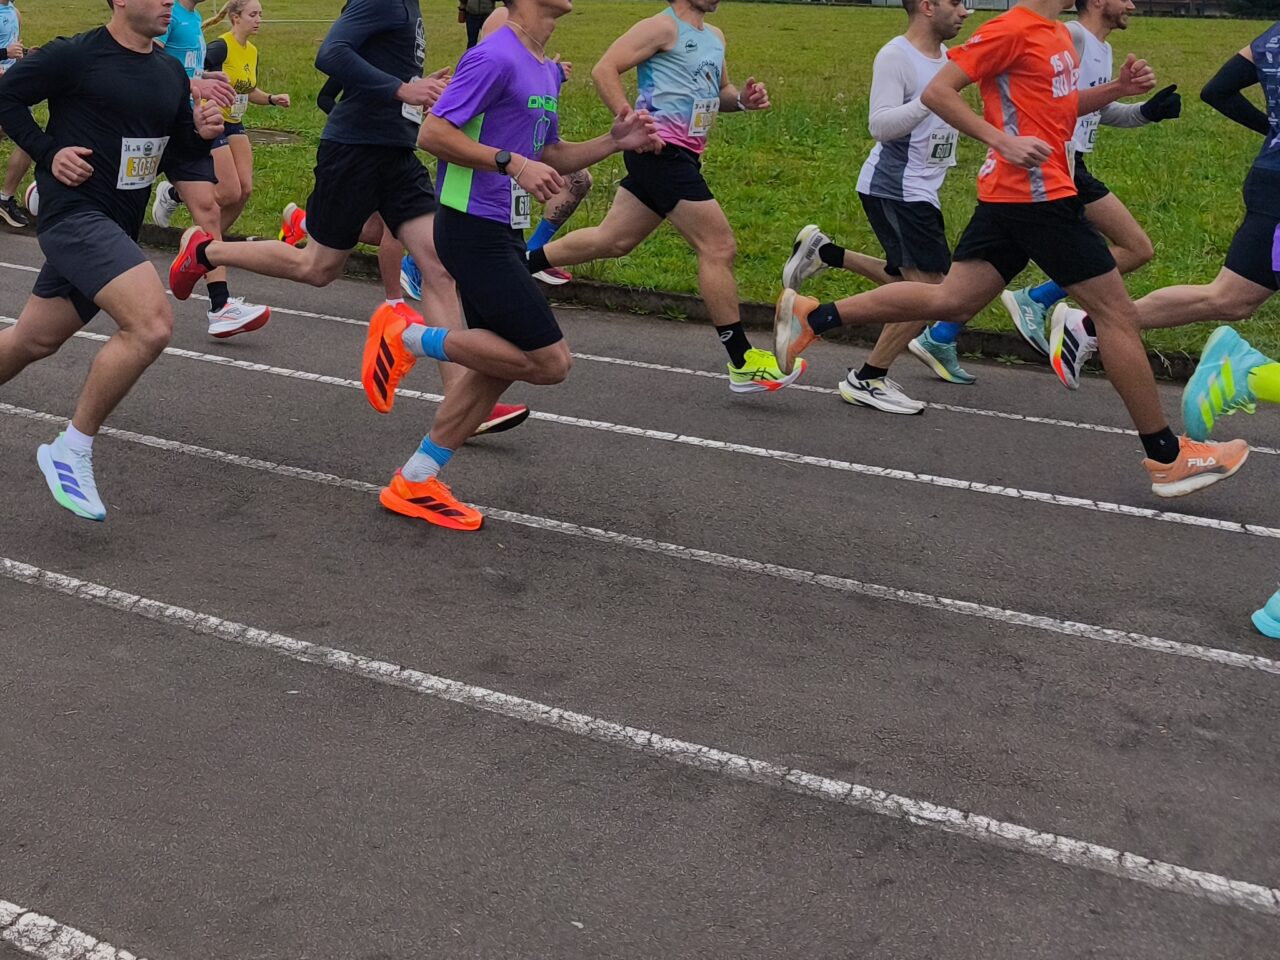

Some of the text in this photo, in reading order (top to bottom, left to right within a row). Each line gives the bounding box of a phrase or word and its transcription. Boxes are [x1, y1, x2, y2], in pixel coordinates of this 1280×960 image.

[527, 95, 545, 109] ON
[1021, 305, 1037, 330] FILA
[1187, 456, 1217, 468] FILA
